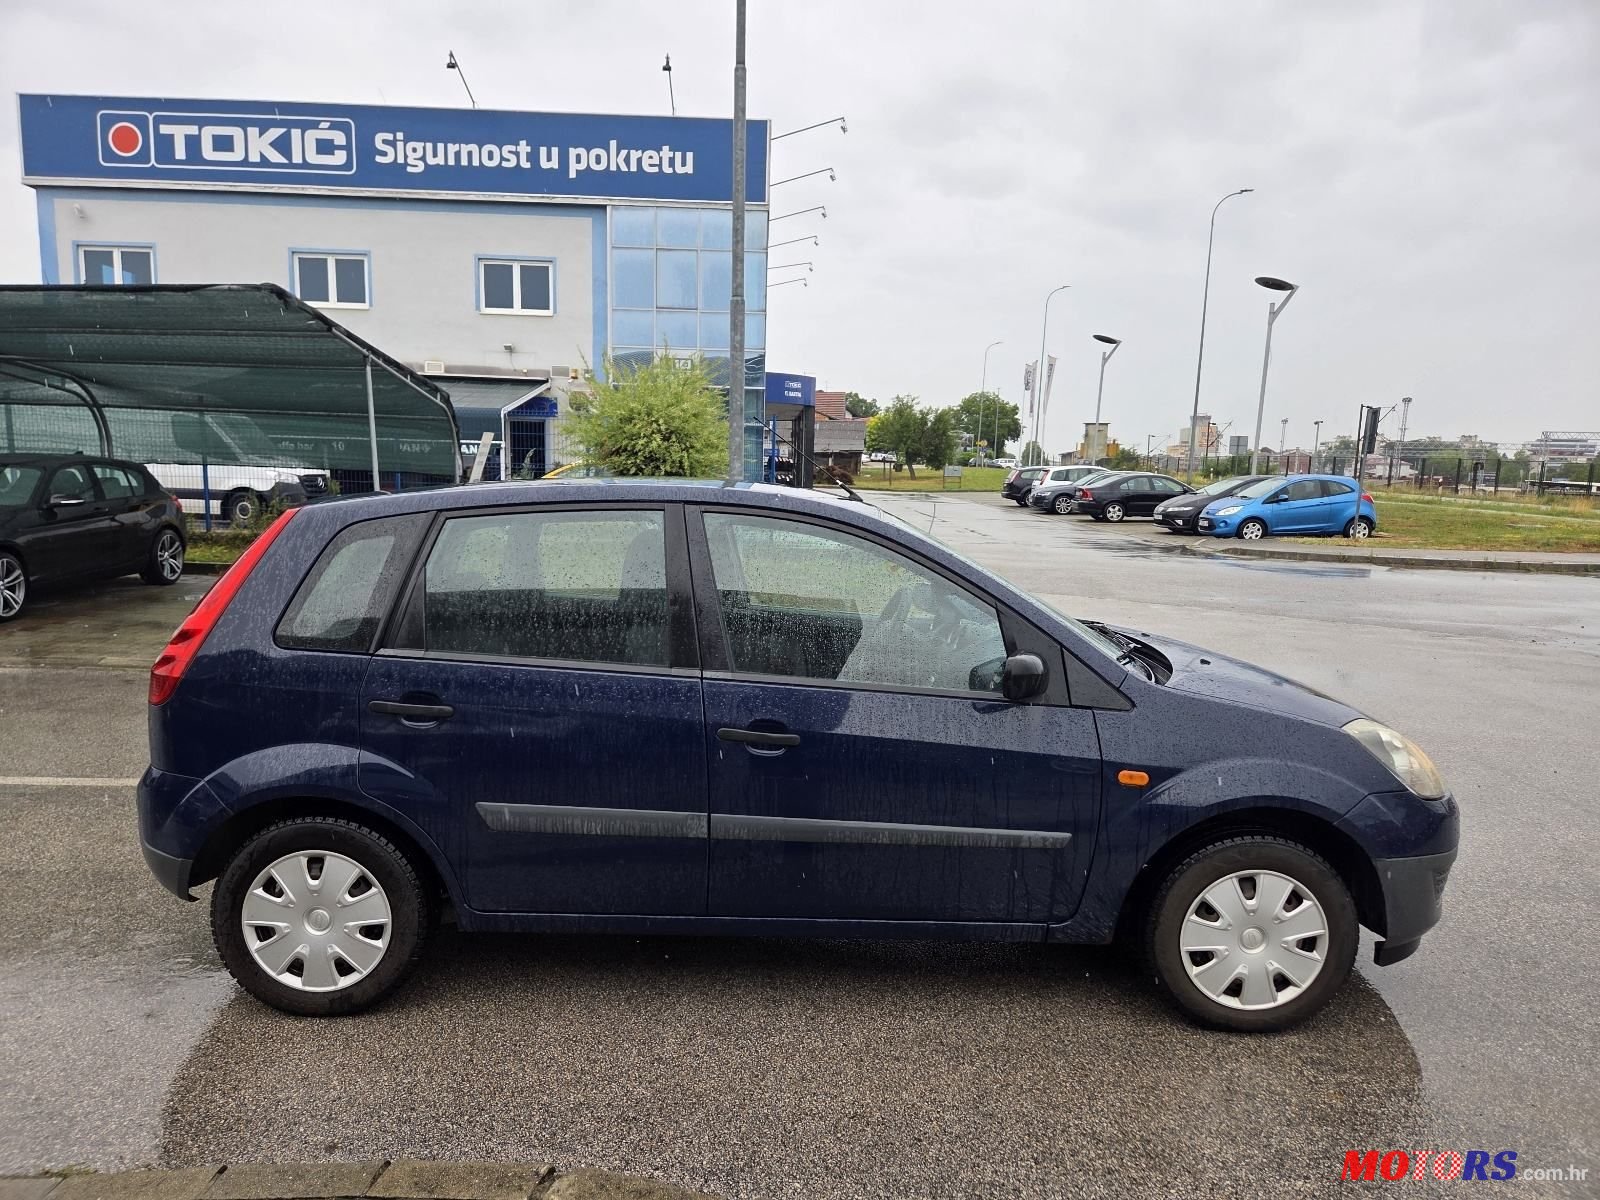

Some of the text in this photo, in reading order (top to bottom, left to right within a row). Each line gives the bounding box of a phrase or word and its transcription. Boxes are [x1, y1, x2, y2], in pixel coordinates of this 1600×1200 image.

[159, 122, 347, 165] TOKIĆ
[374, 132, 694, 179] Sigurnost u pokretu
